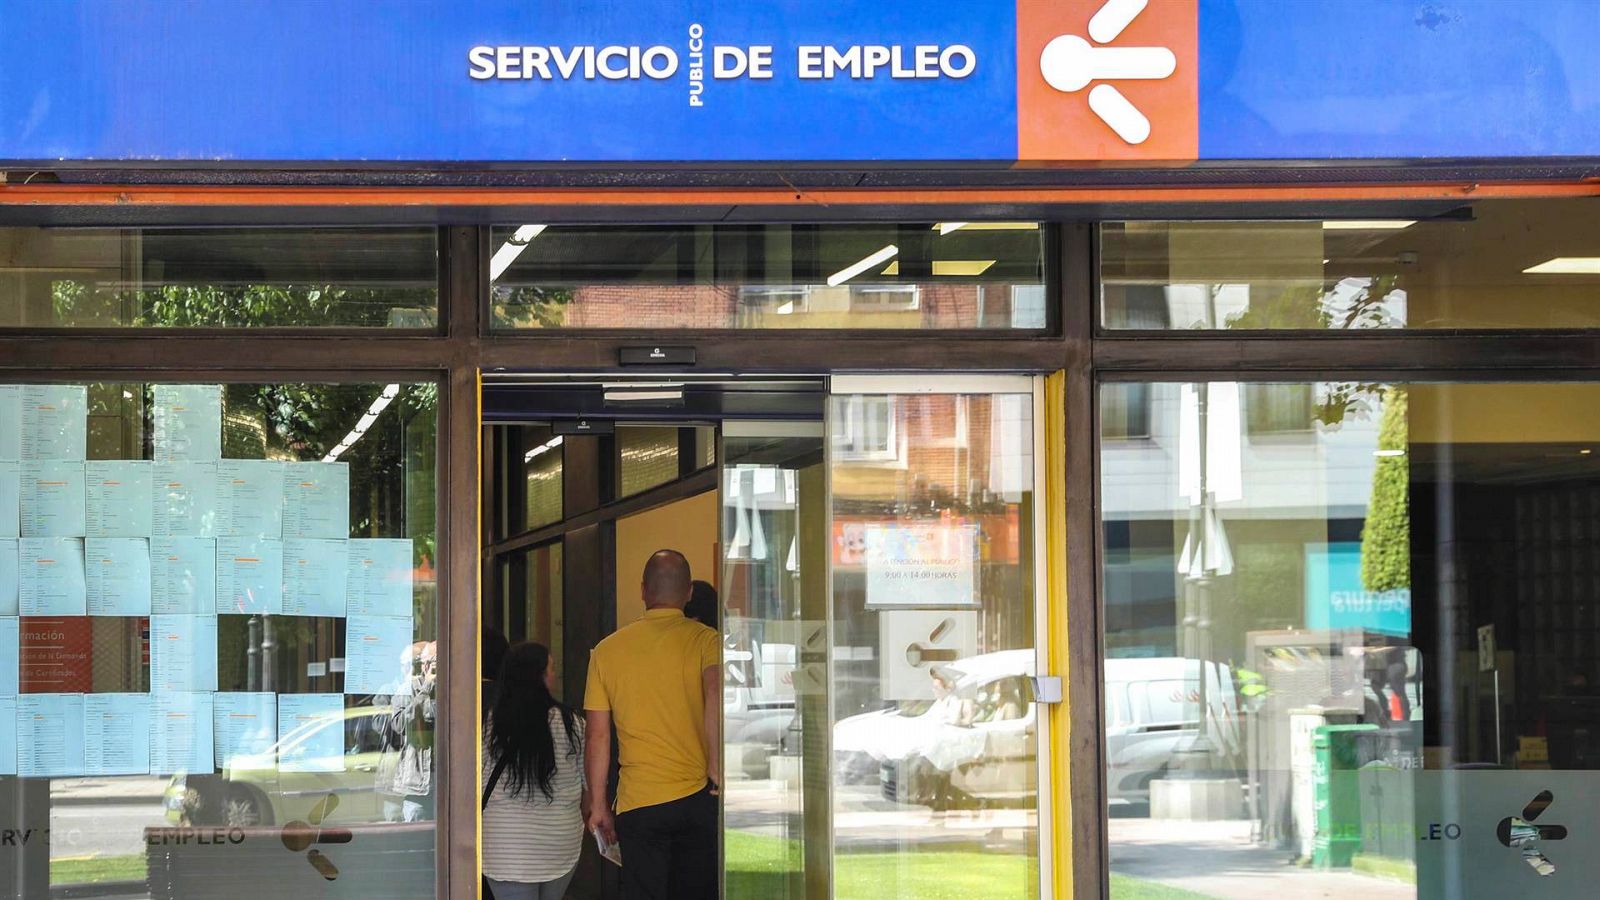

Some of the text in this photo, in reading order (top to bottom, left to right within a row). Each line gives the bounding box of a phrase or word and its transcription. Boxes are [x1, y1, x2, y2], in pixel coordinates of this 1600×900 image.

[468, 45, 679, 80] SERVICIO
[688, 23, 704, 106] PUBLICO
[713, 44, 977, 79] DE EMPLEO
[147, 828, 246, 846] EMPLEO
